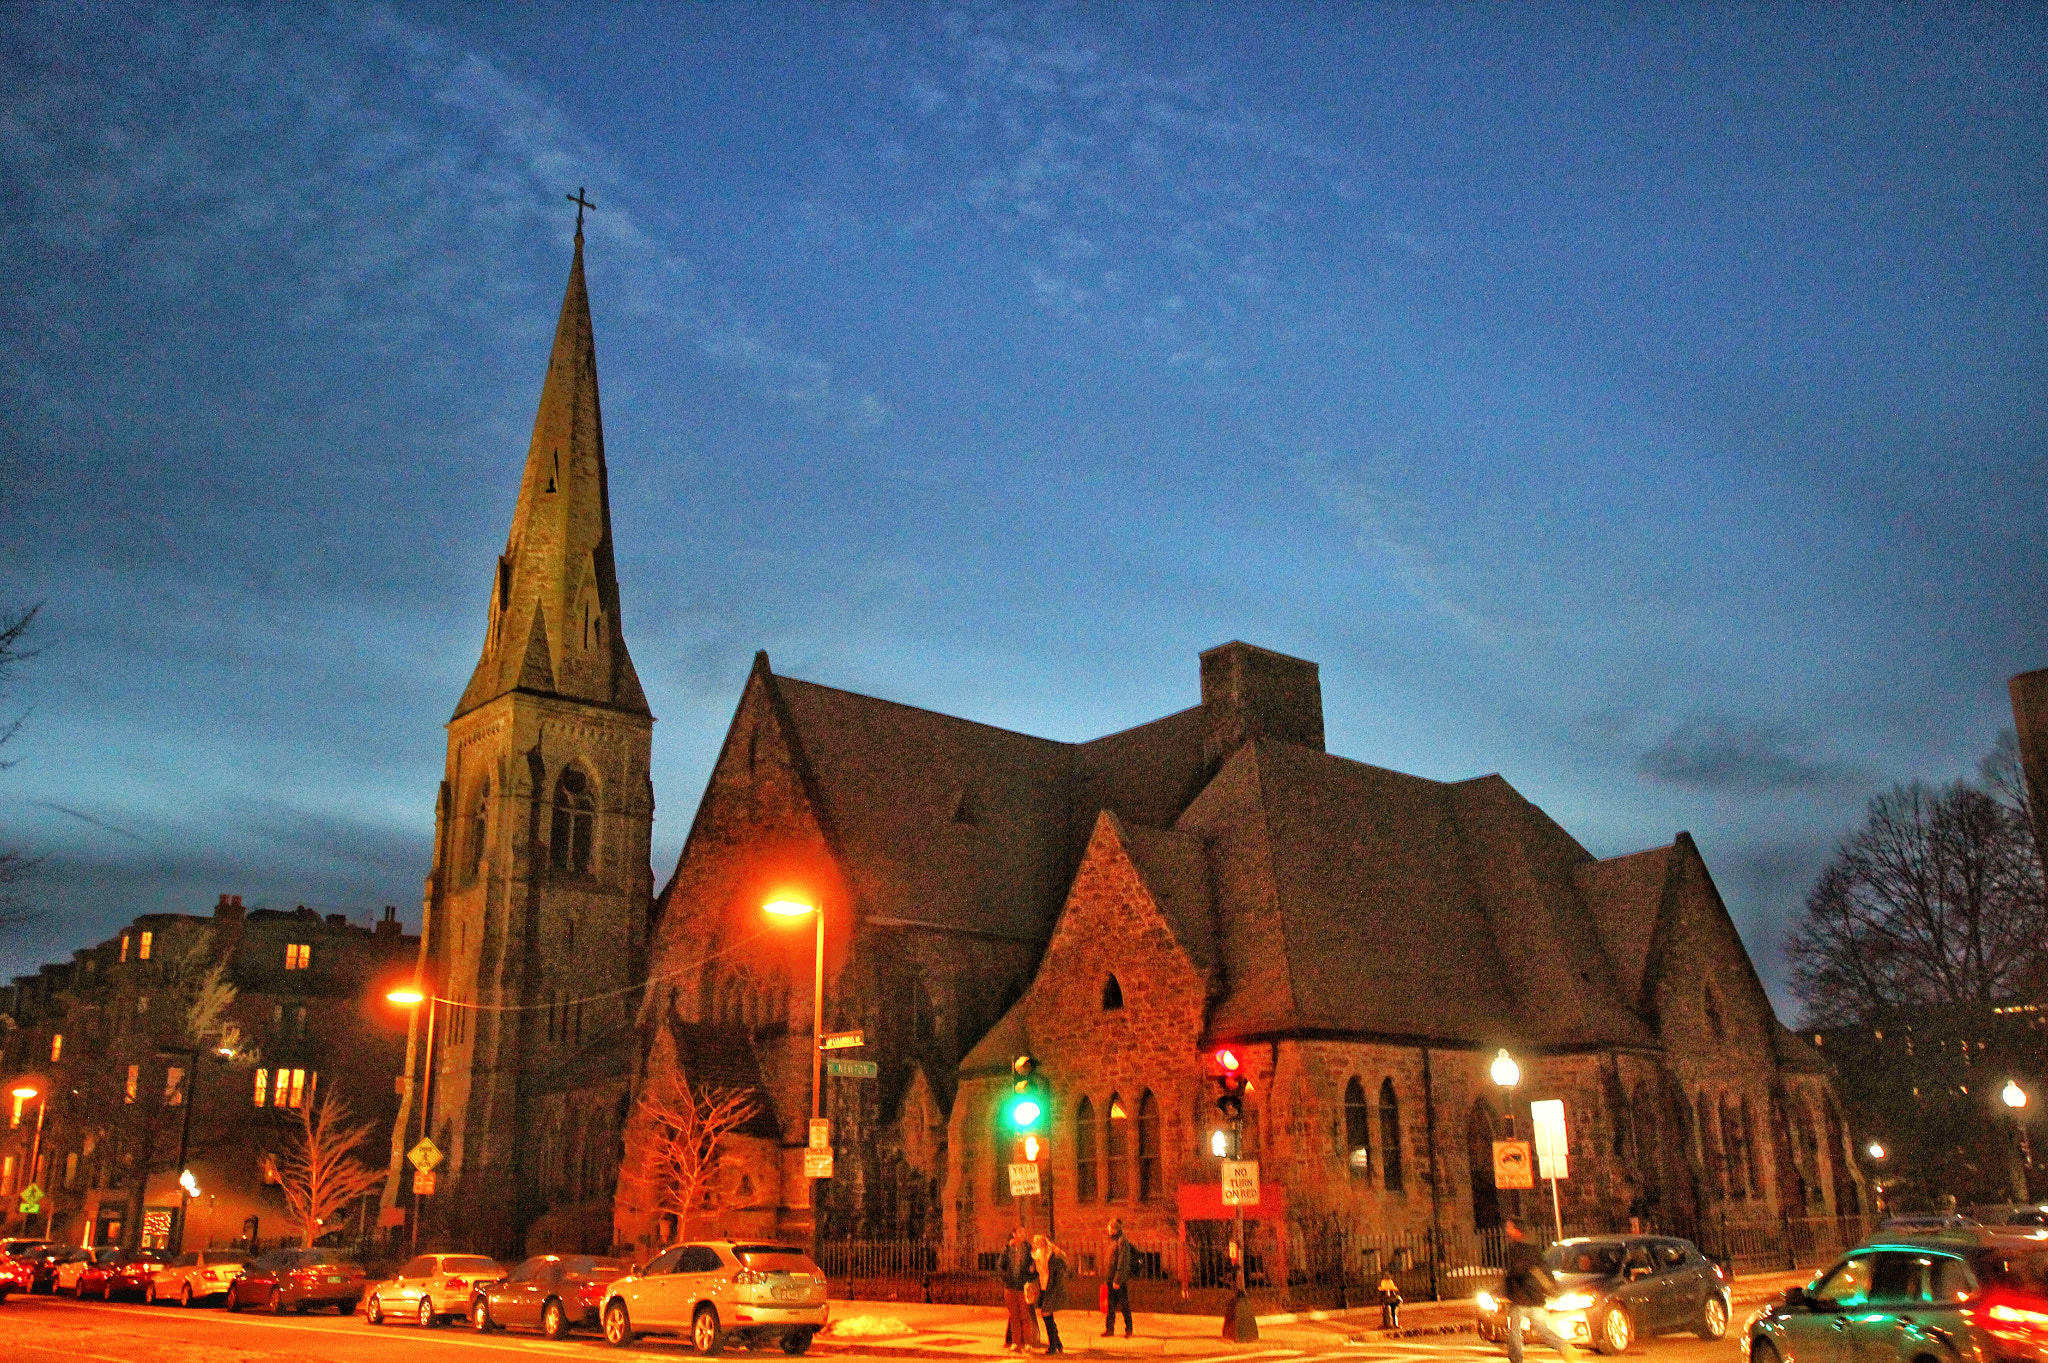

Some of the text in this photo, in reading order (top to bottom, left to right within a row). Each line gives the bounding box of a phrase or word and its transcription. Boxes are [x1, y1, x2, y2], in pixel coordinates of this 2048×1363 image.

[1234, 1168, 1248, 1178] NO
[1230, 1178, 1253, 1188] TURN
[1225, 1189, 1257, 1199] ON RED
